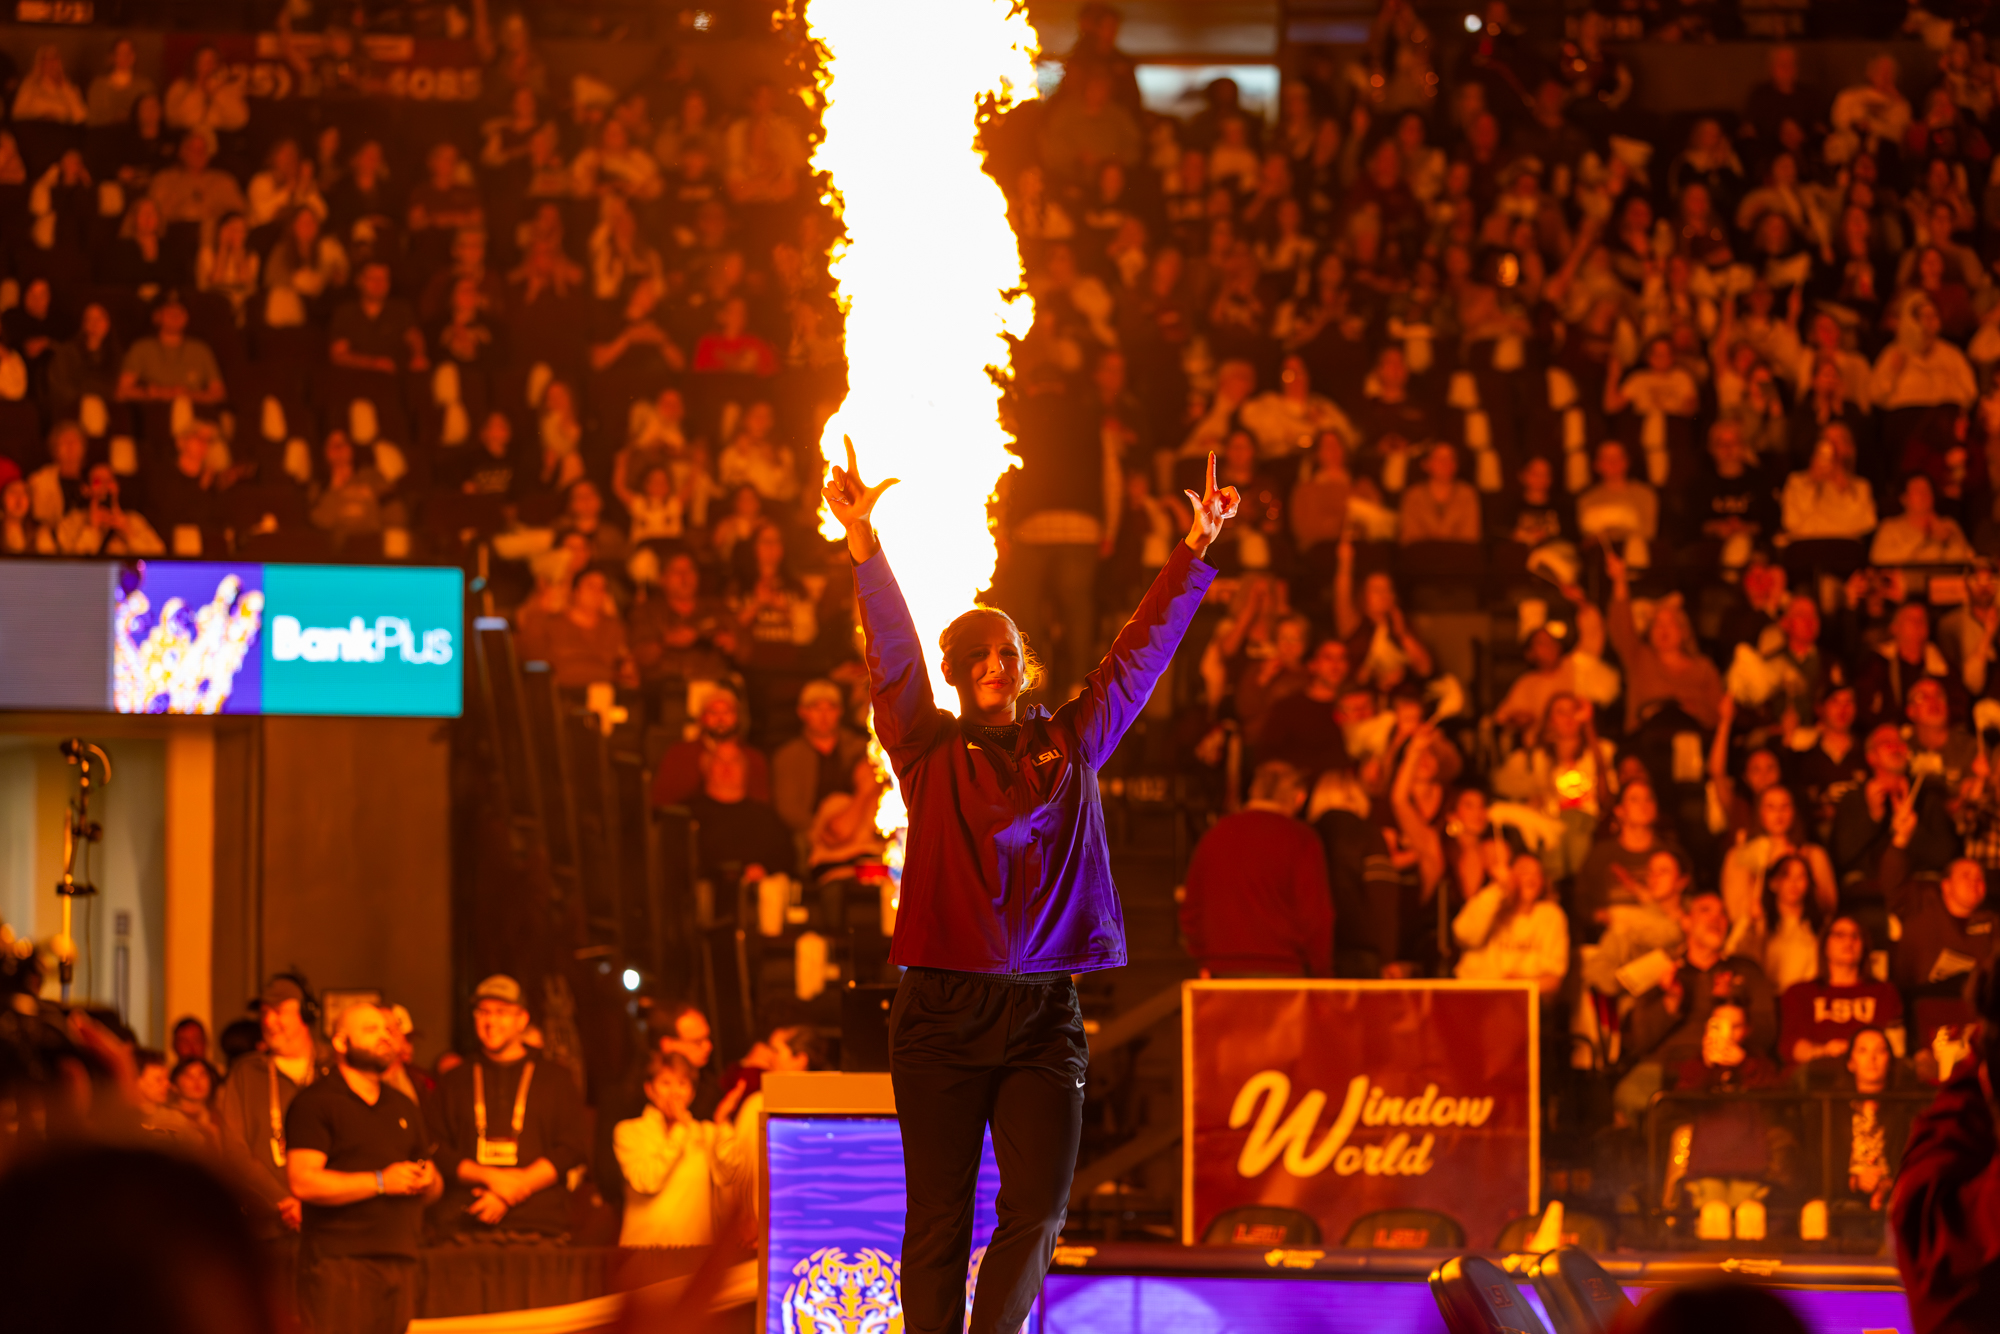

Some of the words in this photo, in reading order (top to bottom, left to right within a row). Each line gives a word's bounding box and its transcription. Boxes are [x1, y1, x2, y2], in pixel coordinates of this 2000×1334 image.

[271, 614, 453, 666] BankPlus
[1031, 748, 1061, 767] LSU
[1813, 996, 1876, 1024] LSU
[1229, 1069, 1494, 1178] Window
